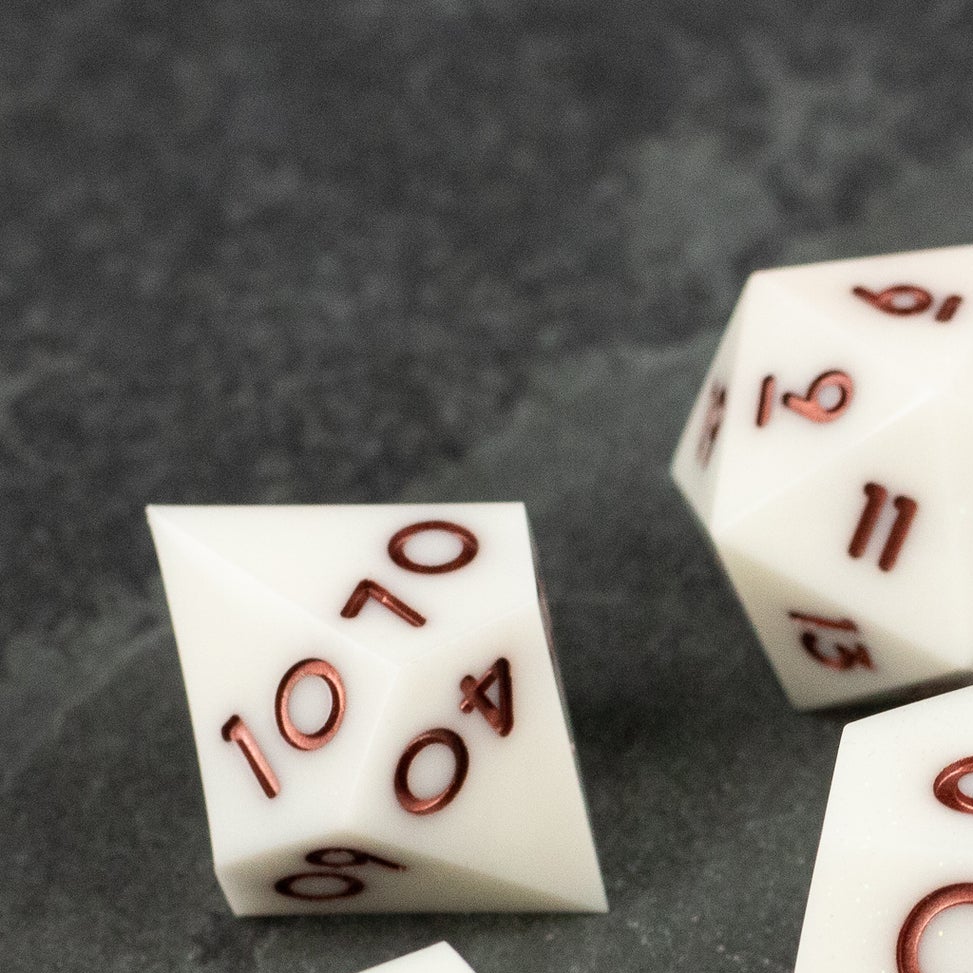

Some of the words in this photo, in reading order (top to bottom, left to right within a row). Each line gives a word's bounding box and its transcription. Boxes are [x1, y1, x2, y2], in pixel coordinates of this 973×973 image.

[340, 519, 480, 628] 70
[847, 481, 920, 573] 11
[221, 656, 348, 802] 10
[393, 656, 516, 818] 40
